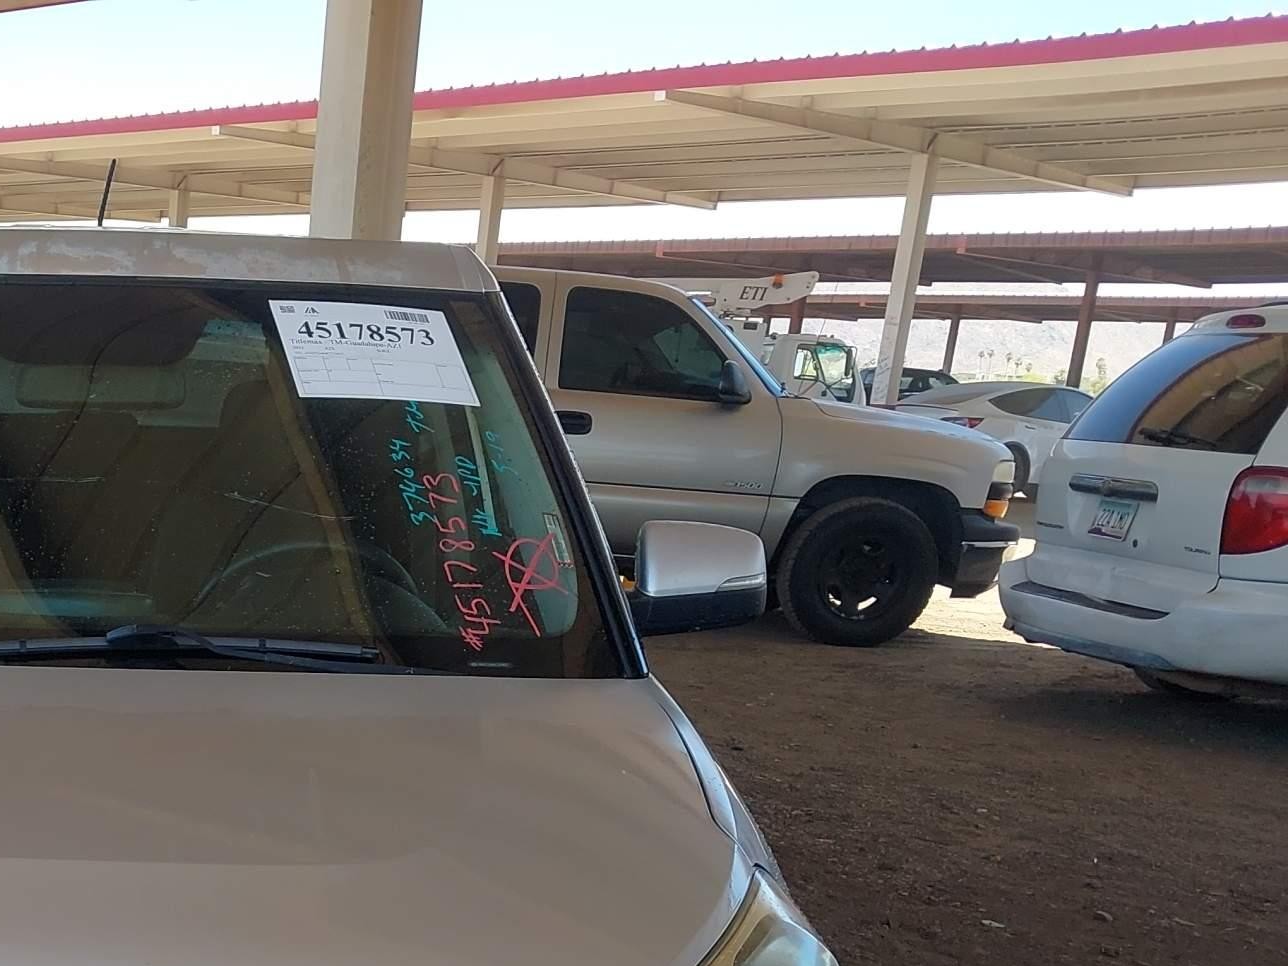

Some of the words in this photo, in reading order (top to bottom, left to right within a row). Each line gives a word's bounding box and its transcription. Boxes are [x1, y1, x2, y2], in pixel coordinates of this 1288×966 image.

[739, 285, 769, 301] ETI
[297, 319, 435, 346] 45178573
[423, 473, 502, 652] #45178573
